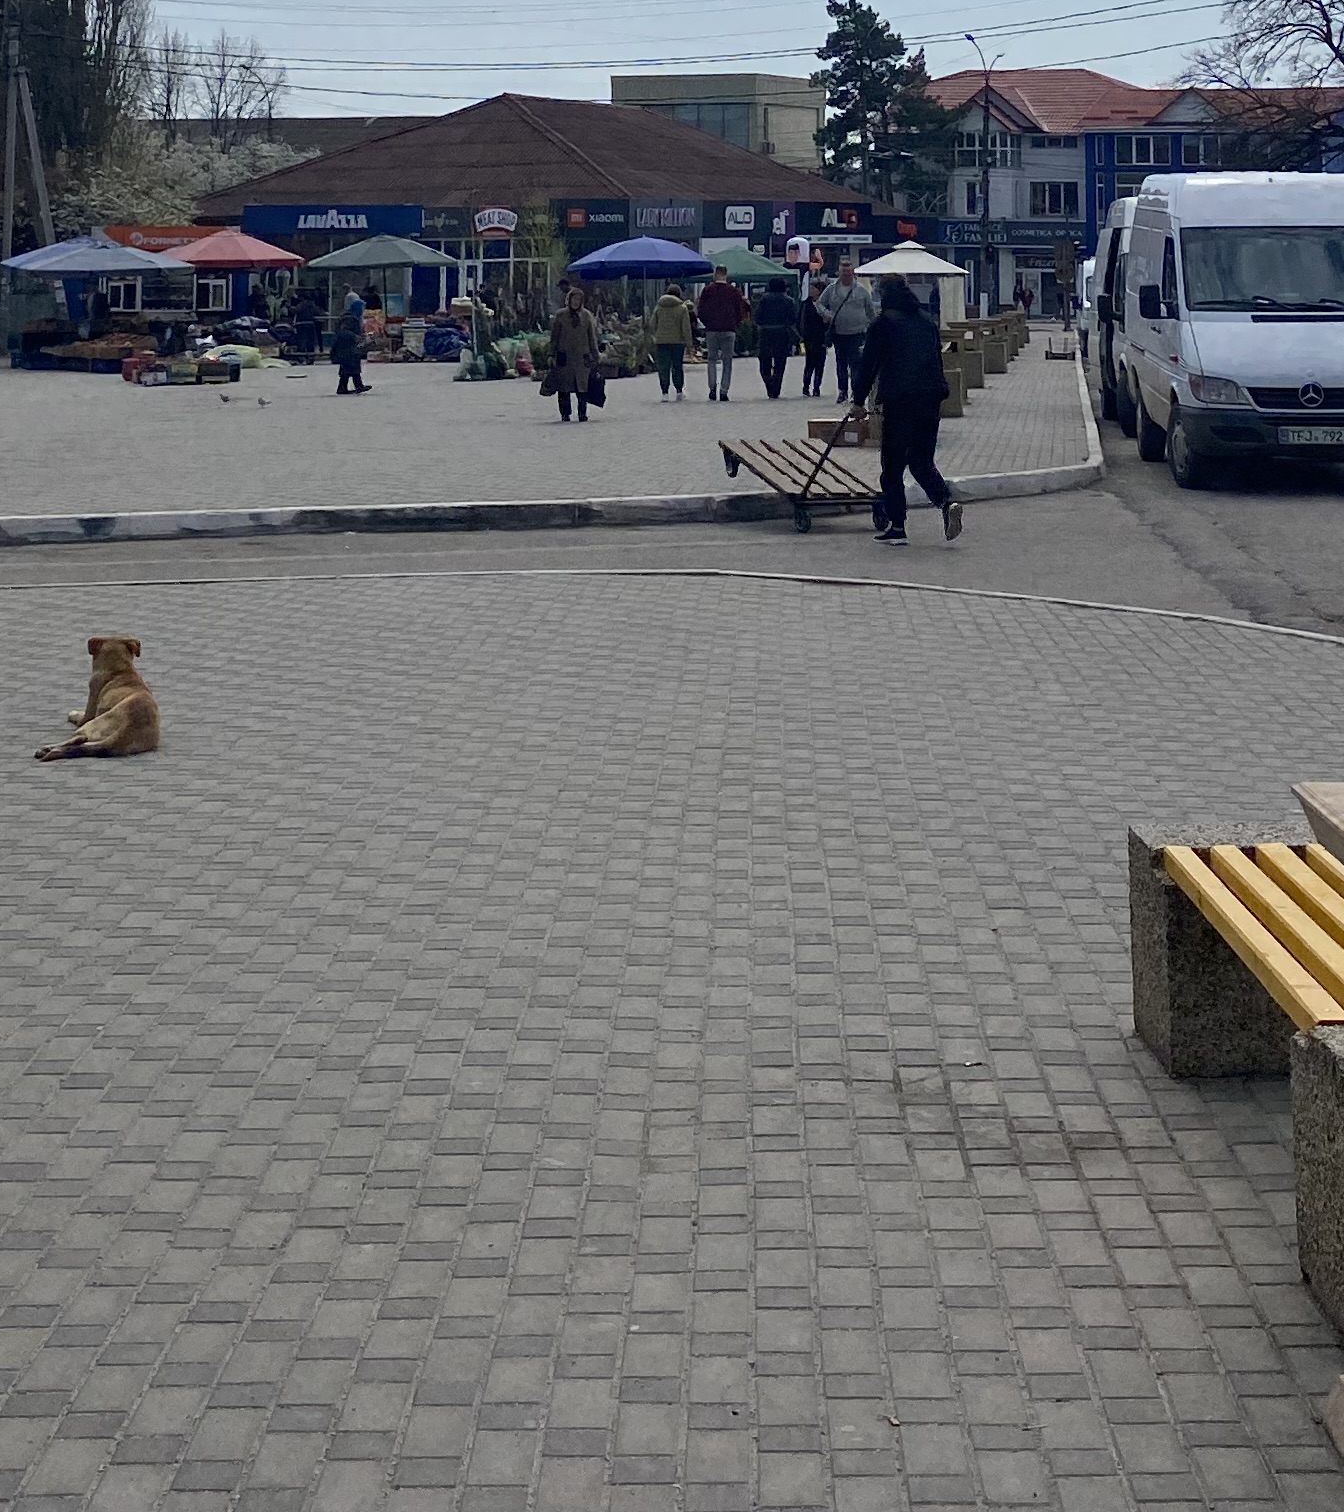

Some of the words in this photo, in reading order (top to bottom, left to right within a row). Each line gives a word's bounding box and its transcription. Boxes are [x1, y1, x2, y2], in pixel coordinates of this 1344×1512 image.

[297, 209, 369, 229] LAVAZZA
[589, 212, 624, 223] xiaomi
[1322, 430, 1343, 442] 792
